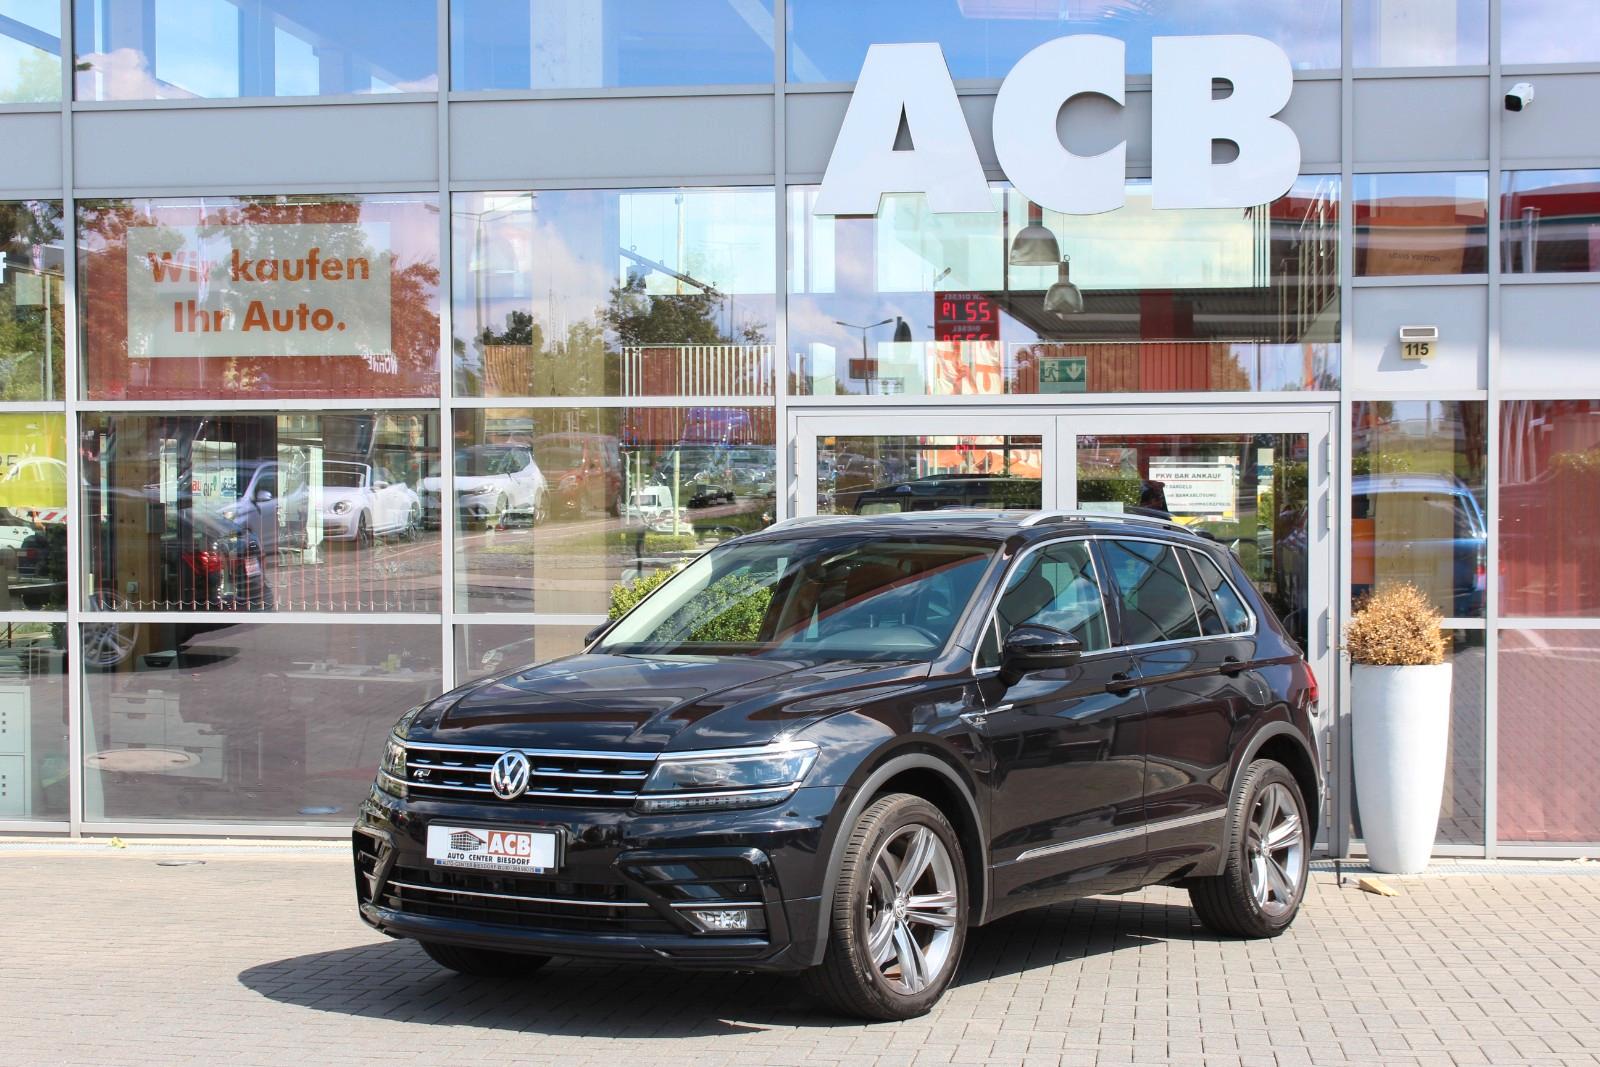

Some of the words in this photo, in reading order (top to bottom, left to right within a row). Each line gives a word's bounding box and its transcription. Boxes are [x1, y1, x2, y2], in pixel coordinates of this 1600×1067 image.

[814, 33, 1300, 216] ACB
[231, 247, 370, 283] kaufen
[173, 300, 225, 333] Ihr
[241, 300, 347, 333] Auto.
[1404, 343, 1429, 356] 115
[489, 832, 531, 856] ACB
[447, 852, 465, 860] AUTO
[468, 853, 493, 863] CENTER
[497, 855, 531, 866] BIESDORF
